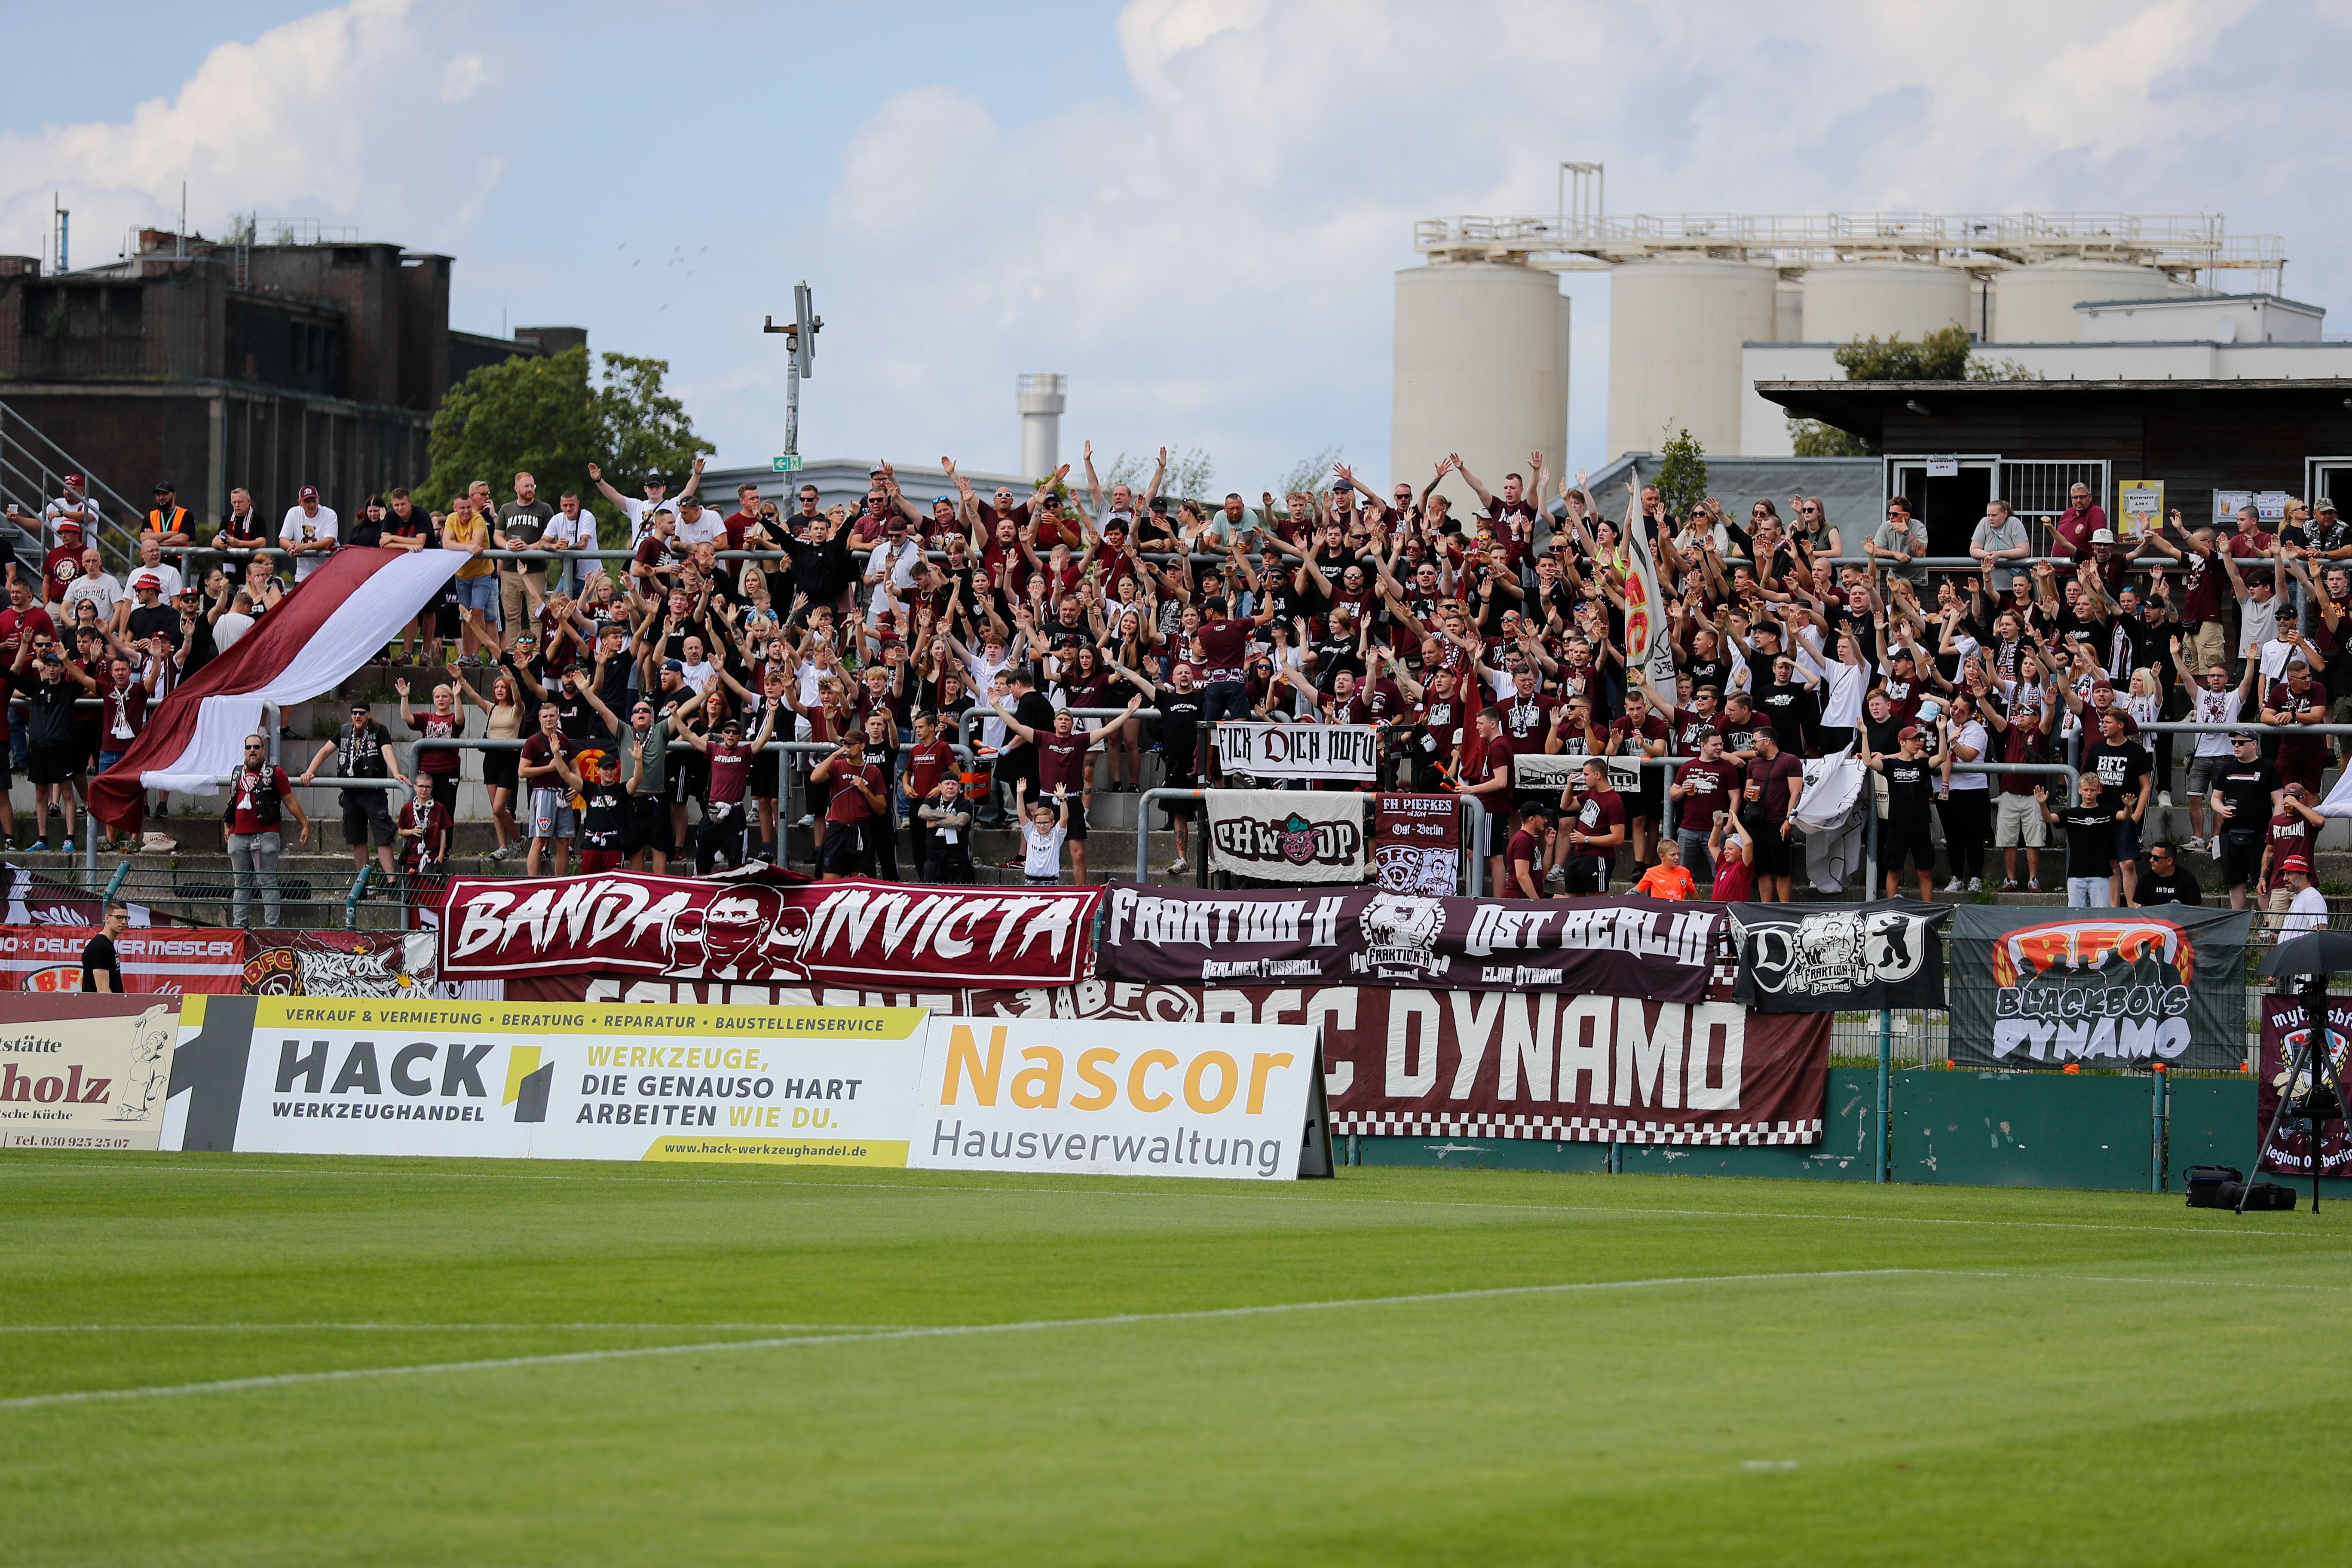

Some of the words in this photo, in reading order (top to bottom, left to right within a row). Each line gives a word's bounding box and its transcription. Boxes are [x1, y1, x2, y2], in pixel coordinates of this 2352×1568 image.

[507, 514, 538, 528] MAYHEM
[1219, 728, 1252, 764] FICK
[1258, 726, 1320, 765] DICH
[2097, 756, 2128, 772] BFC
[2098, 772, 2124, 781] DYNAMO
[1383, 798, 1399, 809] FH
[1403, 799, 1452, 812] PIEFKES
[2281, 820, 2304, 837] DYNAMO
[1376, 849, 1418, 867] BFC
[450, 879, 692, 959] BANDA
[802, 888, 1080, 963] INVICTA
[1108, 888, 1348, 949] FRAKTION-H
[1464, 904, 1559, 957] OST
[1559, 907, 1718, 967] BERLIN
[148, 940, 234, 956] MEISTER
[1369, 948, 1430, 967] FRAKTION-H
[243, 949, 294, 986] BFC
[1201, 959, 1260, 979] BERLINER
[1261, 957, 1323, 978] FUSSBALL
[1394, 967, 1419, 980] BERLIN
[1481, 966, 1514, 984] CLUB
[1514, 965, 1563, 986] DYNAMO
[35, 968, 82, 992] BF
[1813, 982, 1849, 994] Piefkes
[1995, 984, 2191, 1019] BLACKBOYS
[286, 1008, 356, 1022] VERKAUF
[361, 1010, 373, 1022] &
[380, 1011, 482, 1025] VERMIETUNG
[502, 1014, 585, 1027] BERATUNG
[604, 1015, 696, 1029] REPARATUR
[715, 1017, 885, 1032] BAUSTELLENSERVICE
[1384, 989, 1746, 1110] DYNAMO
[1992, 1016, 2192, 1061] DYNAMO
[274, 1039, 496, 1098] HACK
[587, 1045, 770, 1073] WERKZEUGE,
[940, 1024, 1295, 1115] Nascor
[581, 1074, 628, 1096] DIE
[637, 1075, 775, 1099] GENAUSO
[784, 1078, 863, 1101] HART
[33, 1109, 73, 1120] Küche
[273, 1101, 485, 1122] WERKZEUGHANDEL
[575, 1103, 717, 1127] ARBEITEN
[729, 1106, 781, 1128] WIE
[791, 1107, 839, 1129] DU.
[14, 1135, 38, 1146] Tel.
[41, 1136, 65, 1146] 030
[68, 1137, 92, 1147] 925
[95, 1138, 111, 1148] 25
[113, 1138, 131, 1148] 07
[664, 1142, 867, 1158] www.hack-werkzeughandel.de
[931, 1119, 1281, 1177] Hausverwaltung
